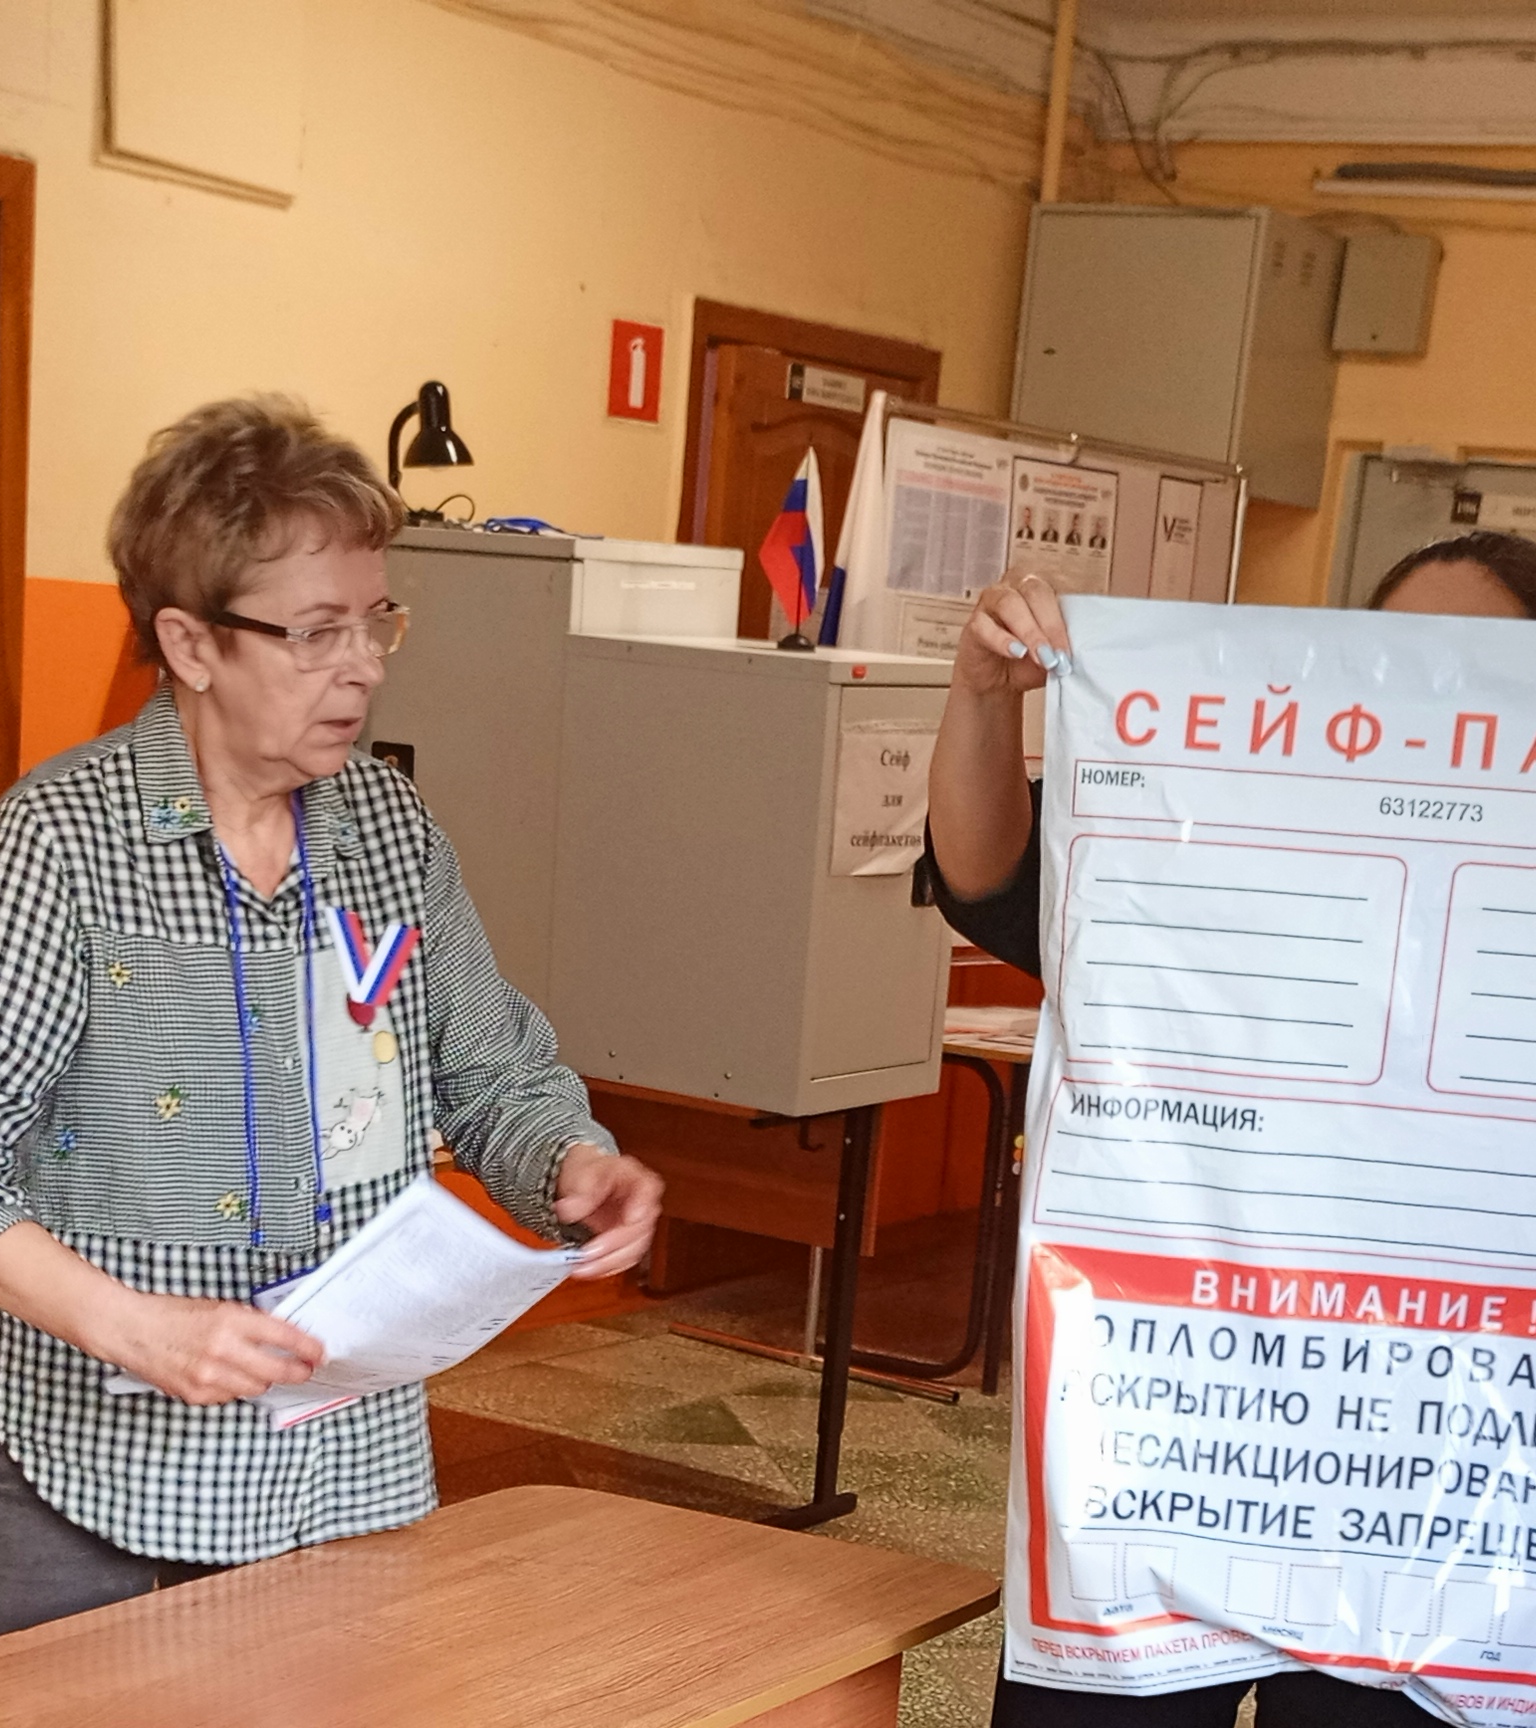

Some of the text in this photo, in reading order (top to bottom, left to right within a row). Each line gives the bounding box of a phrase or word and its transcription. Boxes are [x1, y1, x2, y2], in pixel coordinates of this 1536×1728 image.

[880, 749, 910, 772] Сейф
[1080, 767, 1146, 788] НОМЕР:
[882, 795, 903, 807] для
[1378, 796, 1484, 822] 63122773
[1070, 1092, 1265, 1132] ИНФОРМАЦИЯ:
[1336, 1395, 1393, 1433] НЕ
[1144, 1636, 1200, 1660] ПАКЕТА
